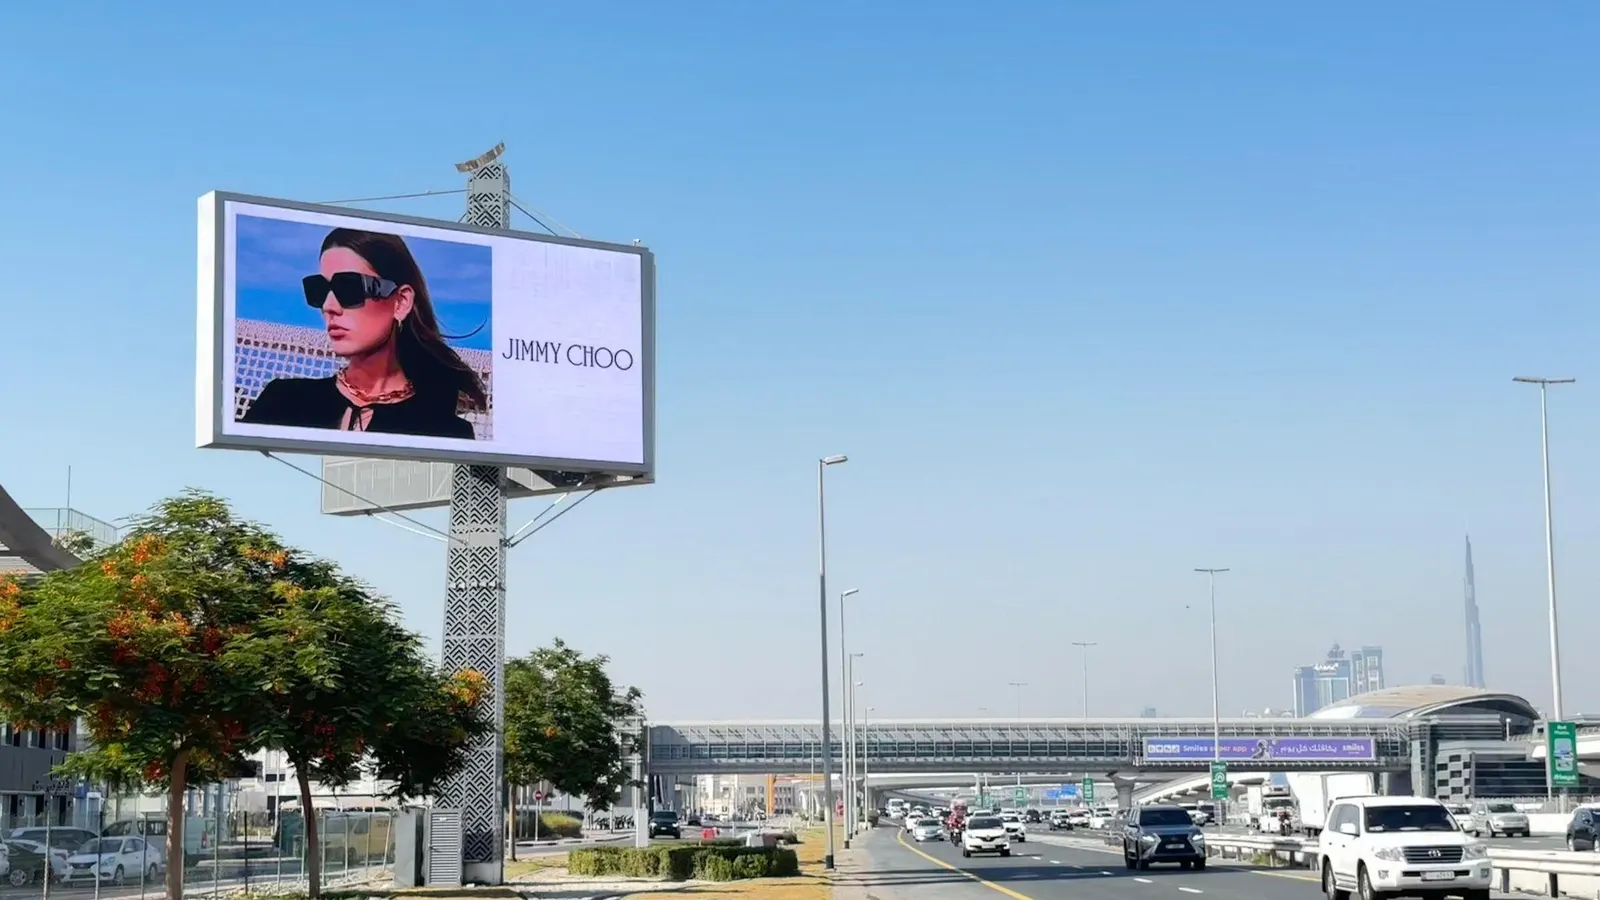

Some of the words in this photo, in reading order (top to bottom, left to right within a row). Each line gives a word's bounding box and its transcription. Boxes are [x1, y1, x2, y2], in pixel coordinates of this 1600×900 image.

[502, 338, 562, 364] JIMMY
[566, 344, 633, 371] CHOO
[1182, 744, 1209, 752] Smiles
